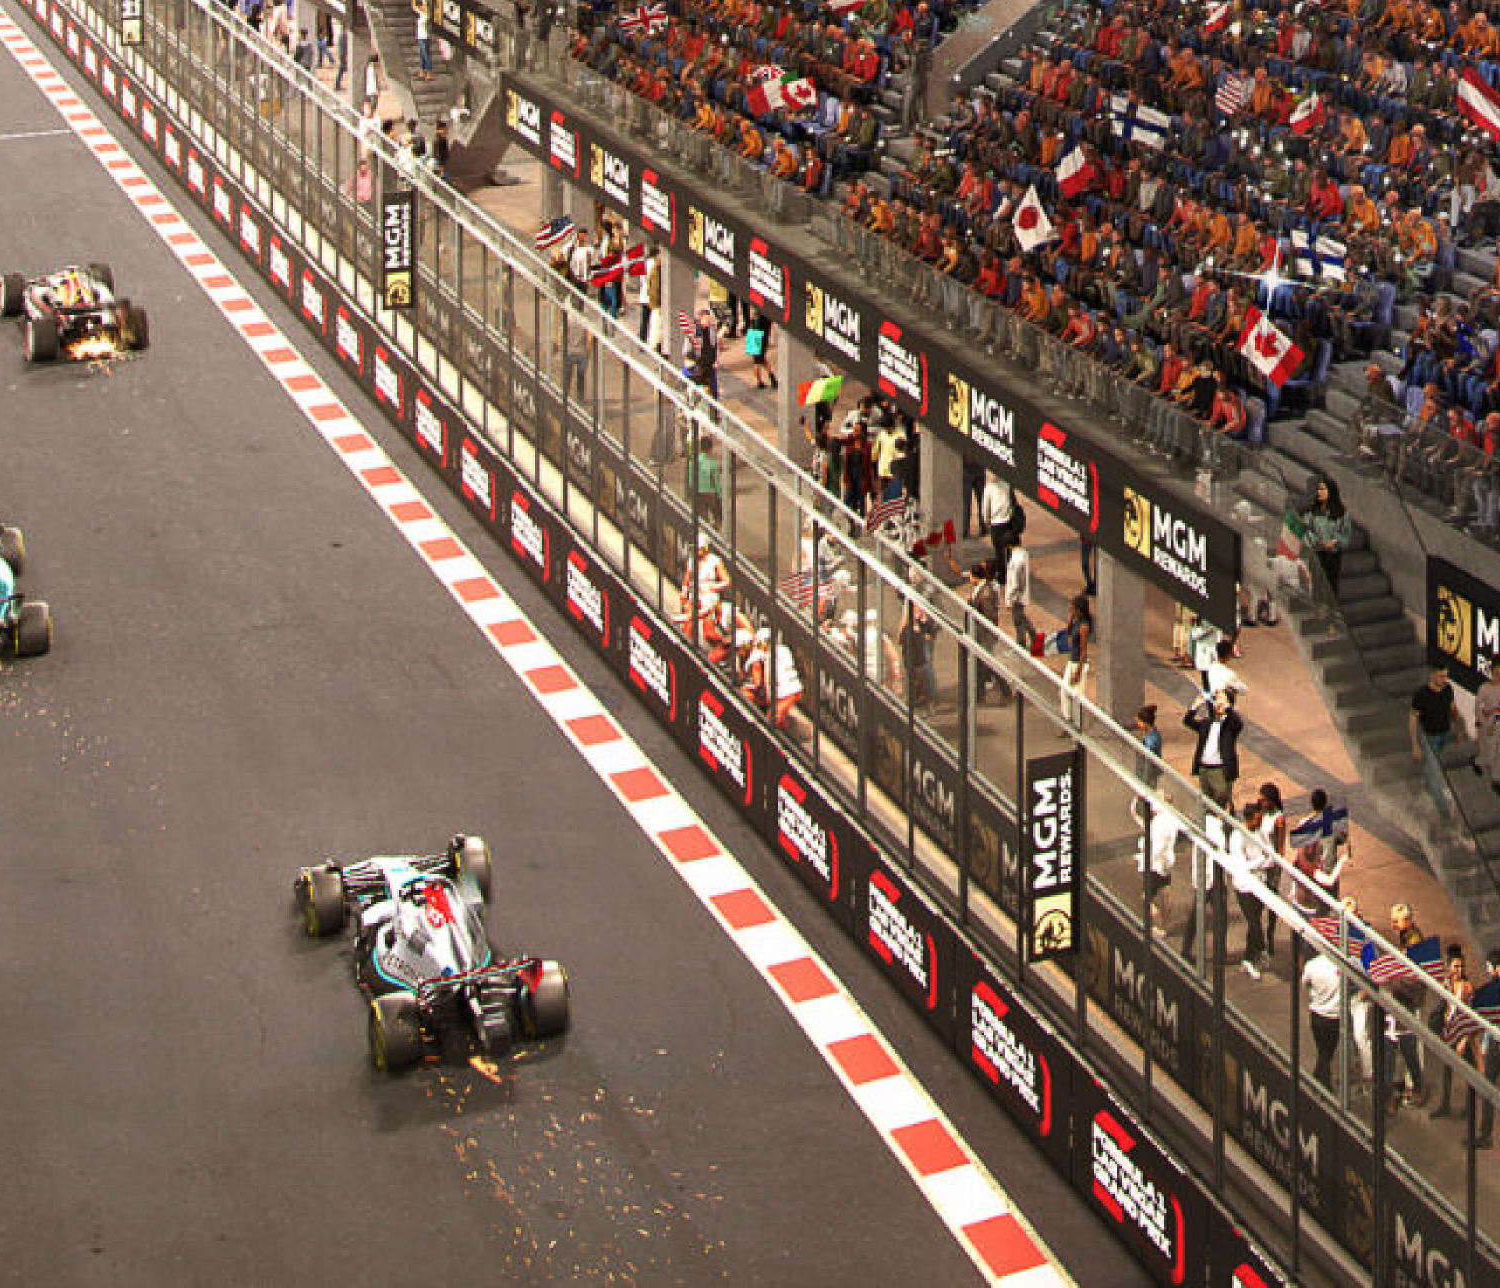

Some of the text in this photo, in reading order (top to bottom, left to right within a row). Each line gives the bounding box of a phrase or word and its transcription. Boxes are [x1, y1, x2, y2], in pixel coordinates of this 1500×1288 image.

[385, 205, 401, 268] MGM
[705, 215, 734, 259] MGM
[825, 293, 861, 343] MGM
[971, 387, 1014, 446] MGM
[1153, 504, 1207, 572] MGM
[1153, 545, 1209, 599] REWARDS
[1033, 777, 1058, 890] MGM
[1059, 772, 1072, 883] REWARDS
[1244, 1071, 1318, 1177] MGM
